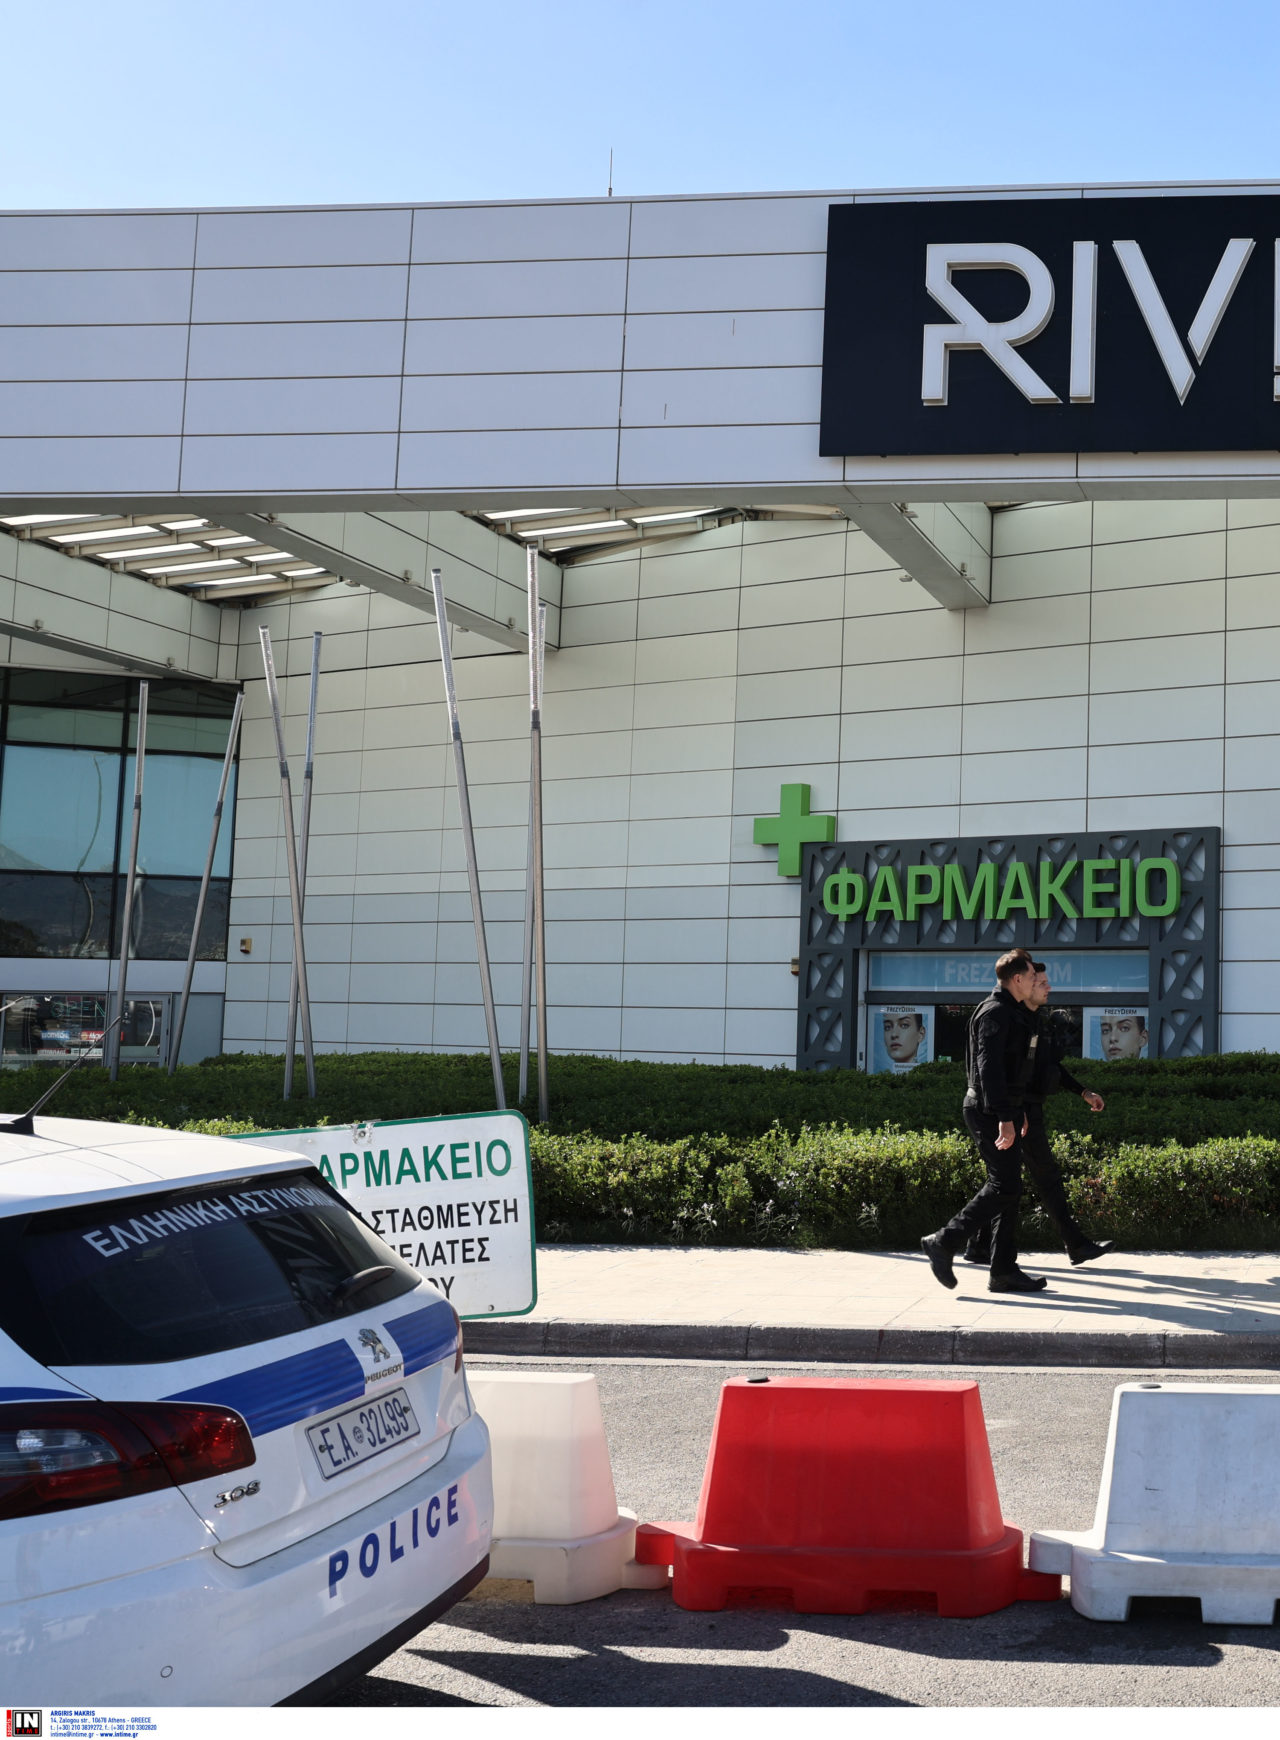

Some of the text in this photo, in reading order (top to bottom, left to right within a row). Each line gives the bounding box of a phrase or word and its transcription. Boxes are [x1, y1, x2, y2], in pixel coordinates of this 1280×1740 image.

[822, 857, 1182, 922] ΦΑΡΜΑΚΕΙΟ
[944, 960, 1073, 985] FREZRM
[319, 1139, 512, 1190] ΑΡΜΑΚΕΙΟ
[82, 1198, 235, 1257] ΕΛΛΗΝΙΚΗ
[391, 1237, 490, 1267] ΕΛΑΤΕΣ
[365, 1363, 404, 1384] PEUGEOT
[360, 1397, 409, 1448] 32499
[214, 1479, 262, 1508] 308
[328, 1485, 460, 1599] POLICE
